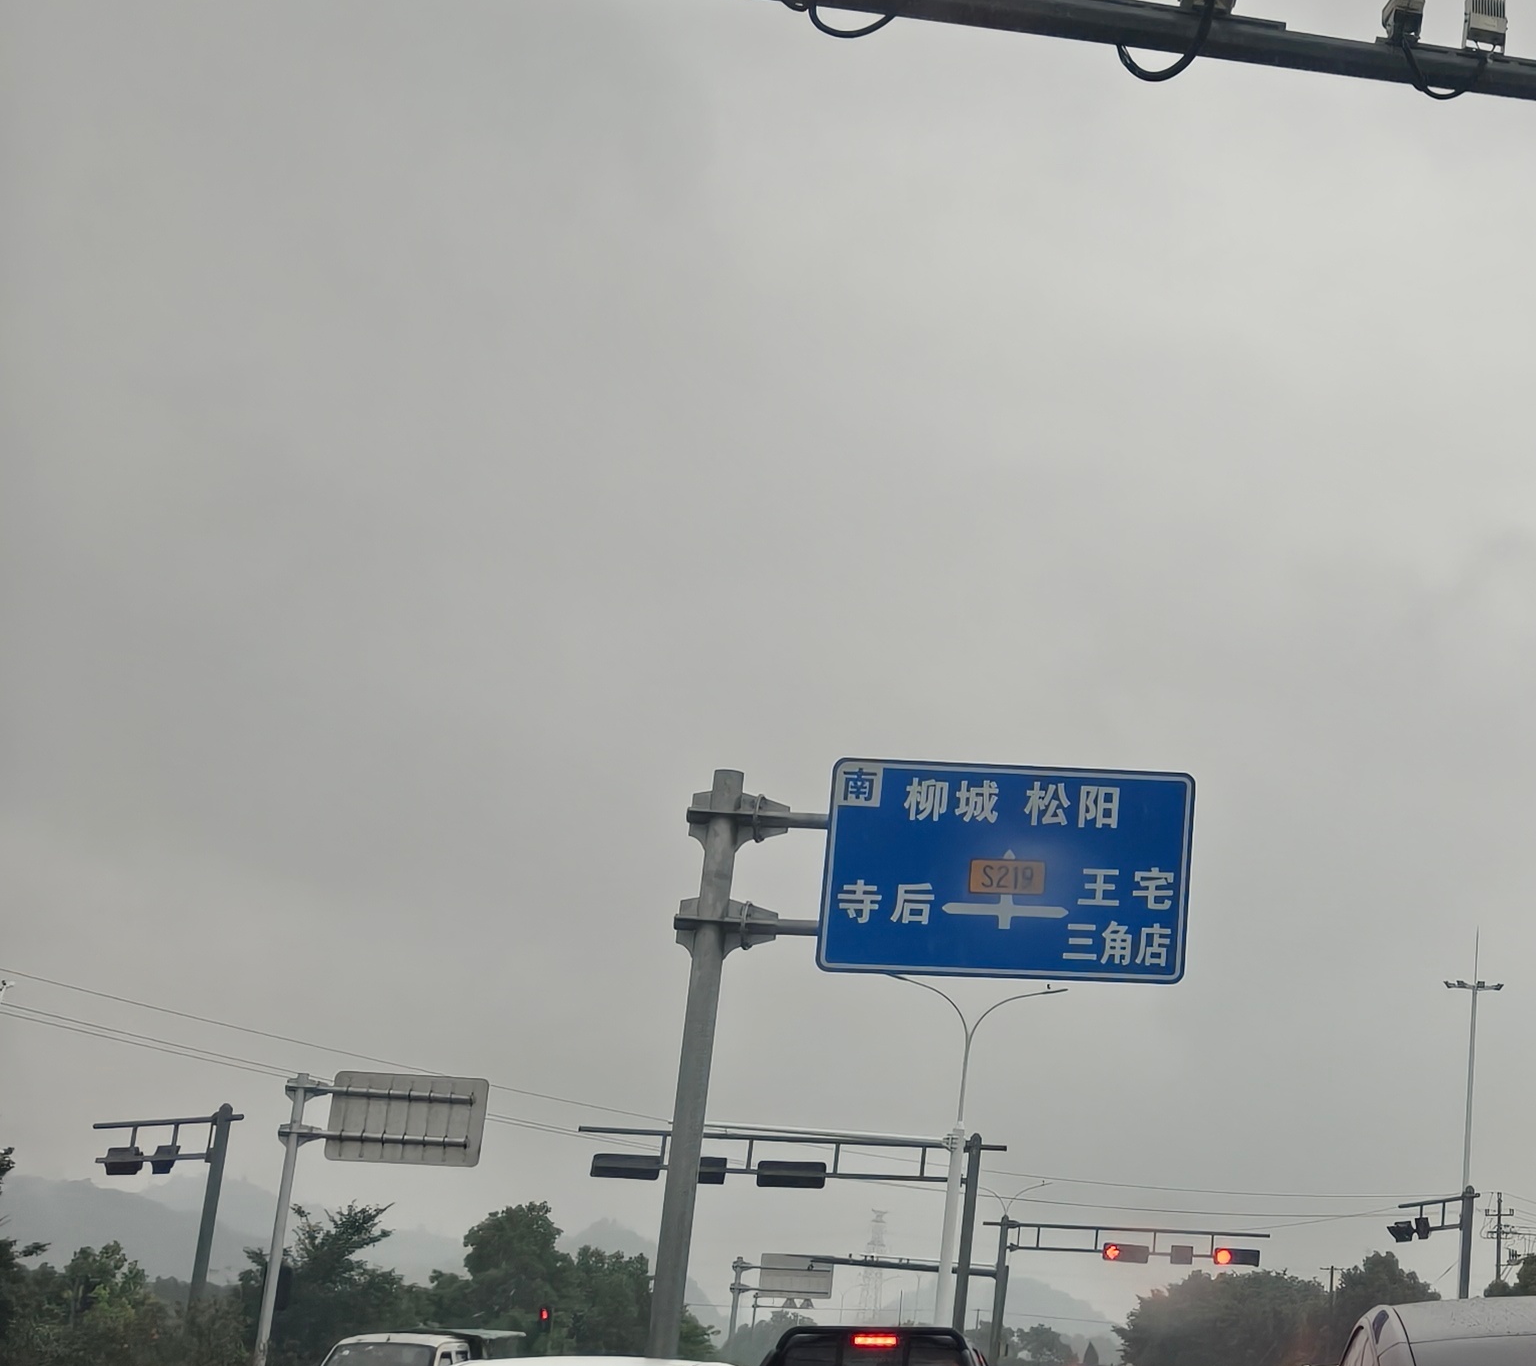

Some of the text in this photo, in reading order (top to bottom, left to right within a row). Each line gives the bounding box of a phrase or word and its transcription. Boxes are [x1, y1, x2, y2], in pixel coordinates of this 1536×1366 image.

[843, 768, 878, 801] 南
[904, 777, 1120, 828] 柳城 松阳
[981, 864, 1034, 889] S219
[1077, 867, 1175, 911] 王宅
[837, 879, 935, 925] 寺后
[1062, 921, 1172, 967] 三角店
